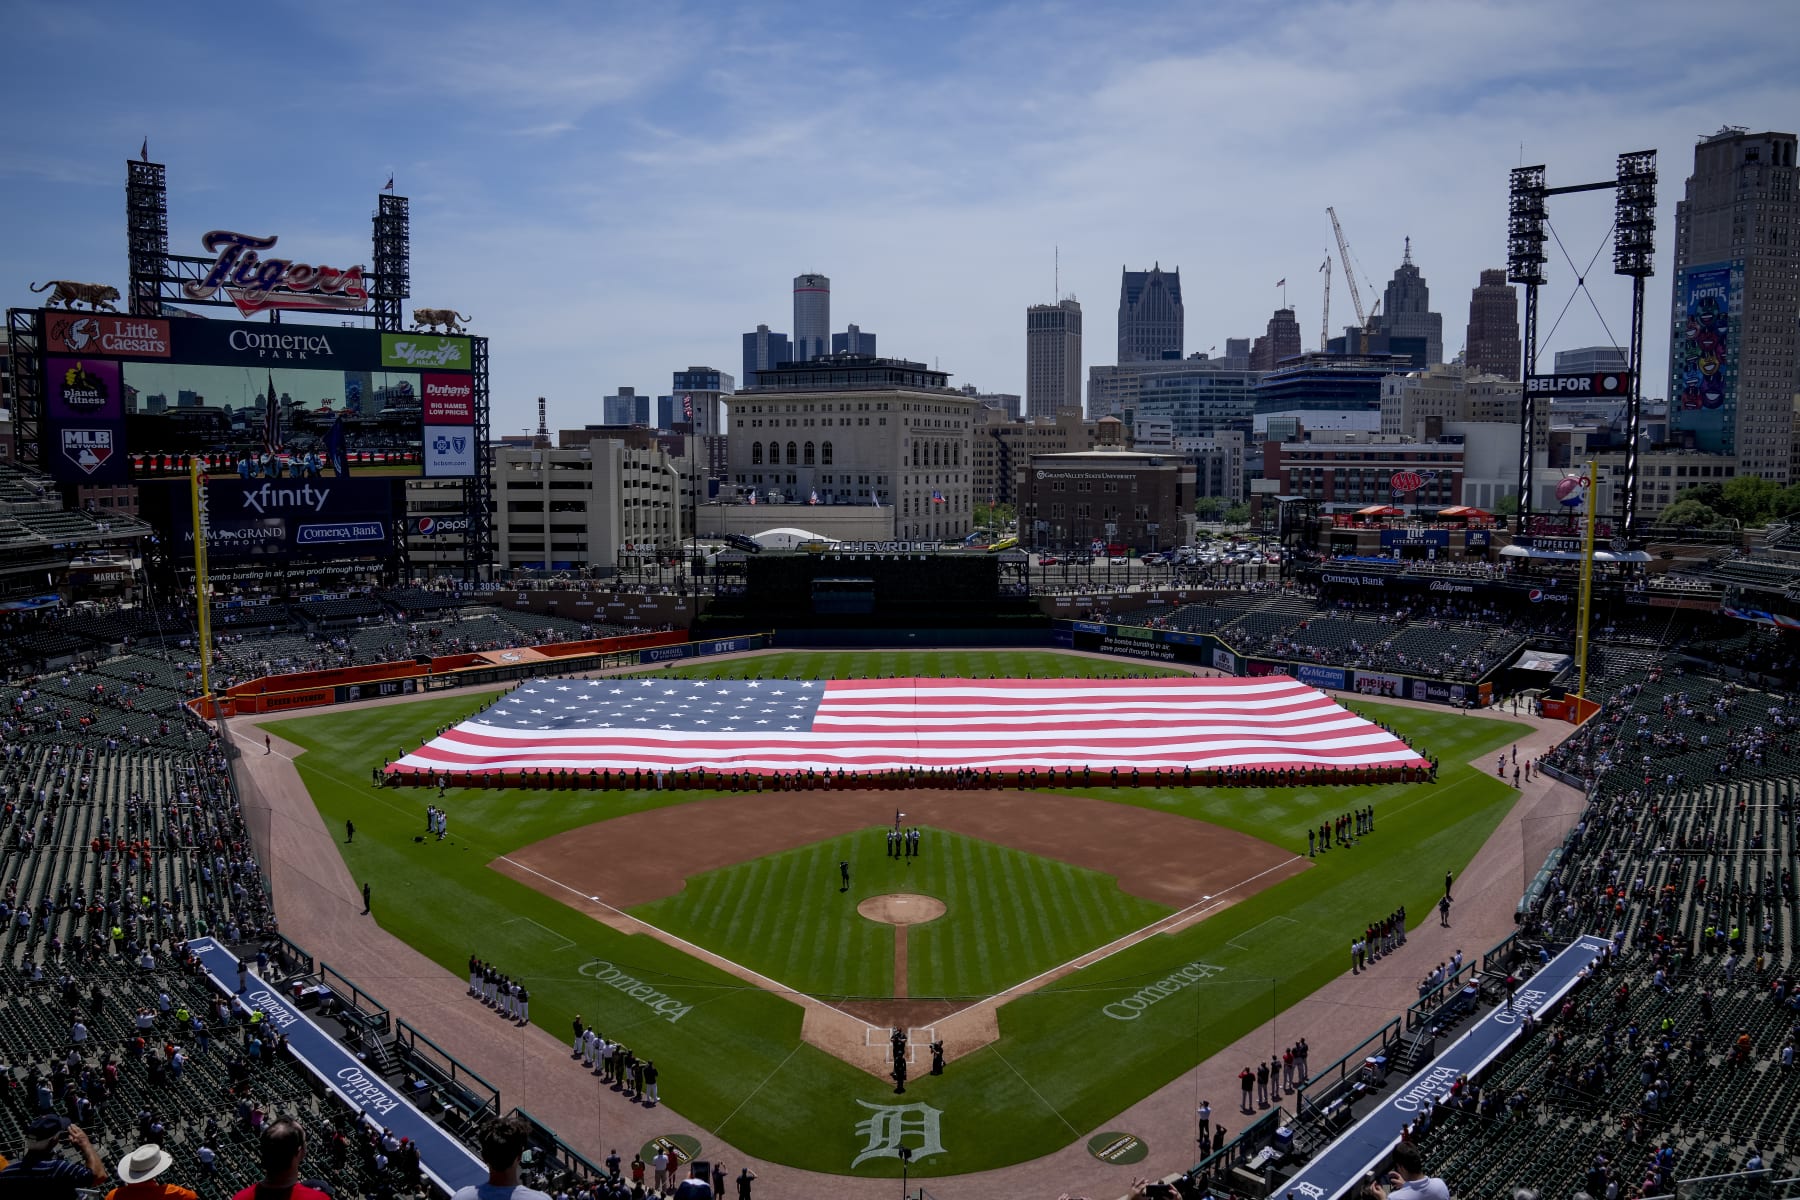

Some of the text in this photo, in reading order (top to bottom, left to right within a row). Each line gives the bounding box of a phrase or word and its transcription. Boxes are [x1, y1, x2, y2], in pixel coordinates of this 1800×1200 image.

[183, 230, 369, 312] Tigers
[1690, 286, 1727, 306] HOME
[114, 321, 159, 340] Little
[102, 333, 166, 353] Caesars
[259, 350, 307, 360] PARK
[427, 383, 471, 396] Dunham's
[1528, 377, 1592, 392] BELFOR
[64, 388, 99, 399] planet
[69, 396, 106, 405] fitness
[64, 431, 110, 444] MLB
[1393, 472, 1421, 490] AAA
[242, 483, 332, 514] xfinity
[352, 525, 378, 536] Bank
[437, 518, 469, 533] pepsi
[237, 528, 283, 539] GRAND
[841, 541, 942, 552] CHEVROLET
[93, 571, 125, 582] MARKET
[233, 571, 264, 583] bursting
[264, 571, 273, 580] in
[286, 569, 305, 579] gave
[306, 566, 326, 578] proof
[326, 563, 353, 577] through
[353, 564, 365, 573] the
[366, 561, 384, 574] night
[1361, 575, 1384, 587] Bank
[1543, 592, 1569, 602] pepsi
[715, 641, 736, 654] DTE
[1312, 668, 1343, 680] McLaren
[380, 682, 399, 696] Lite
[1359, 677, 1397, 691] meijer
[341, 1083, 371, 1107] PARK
